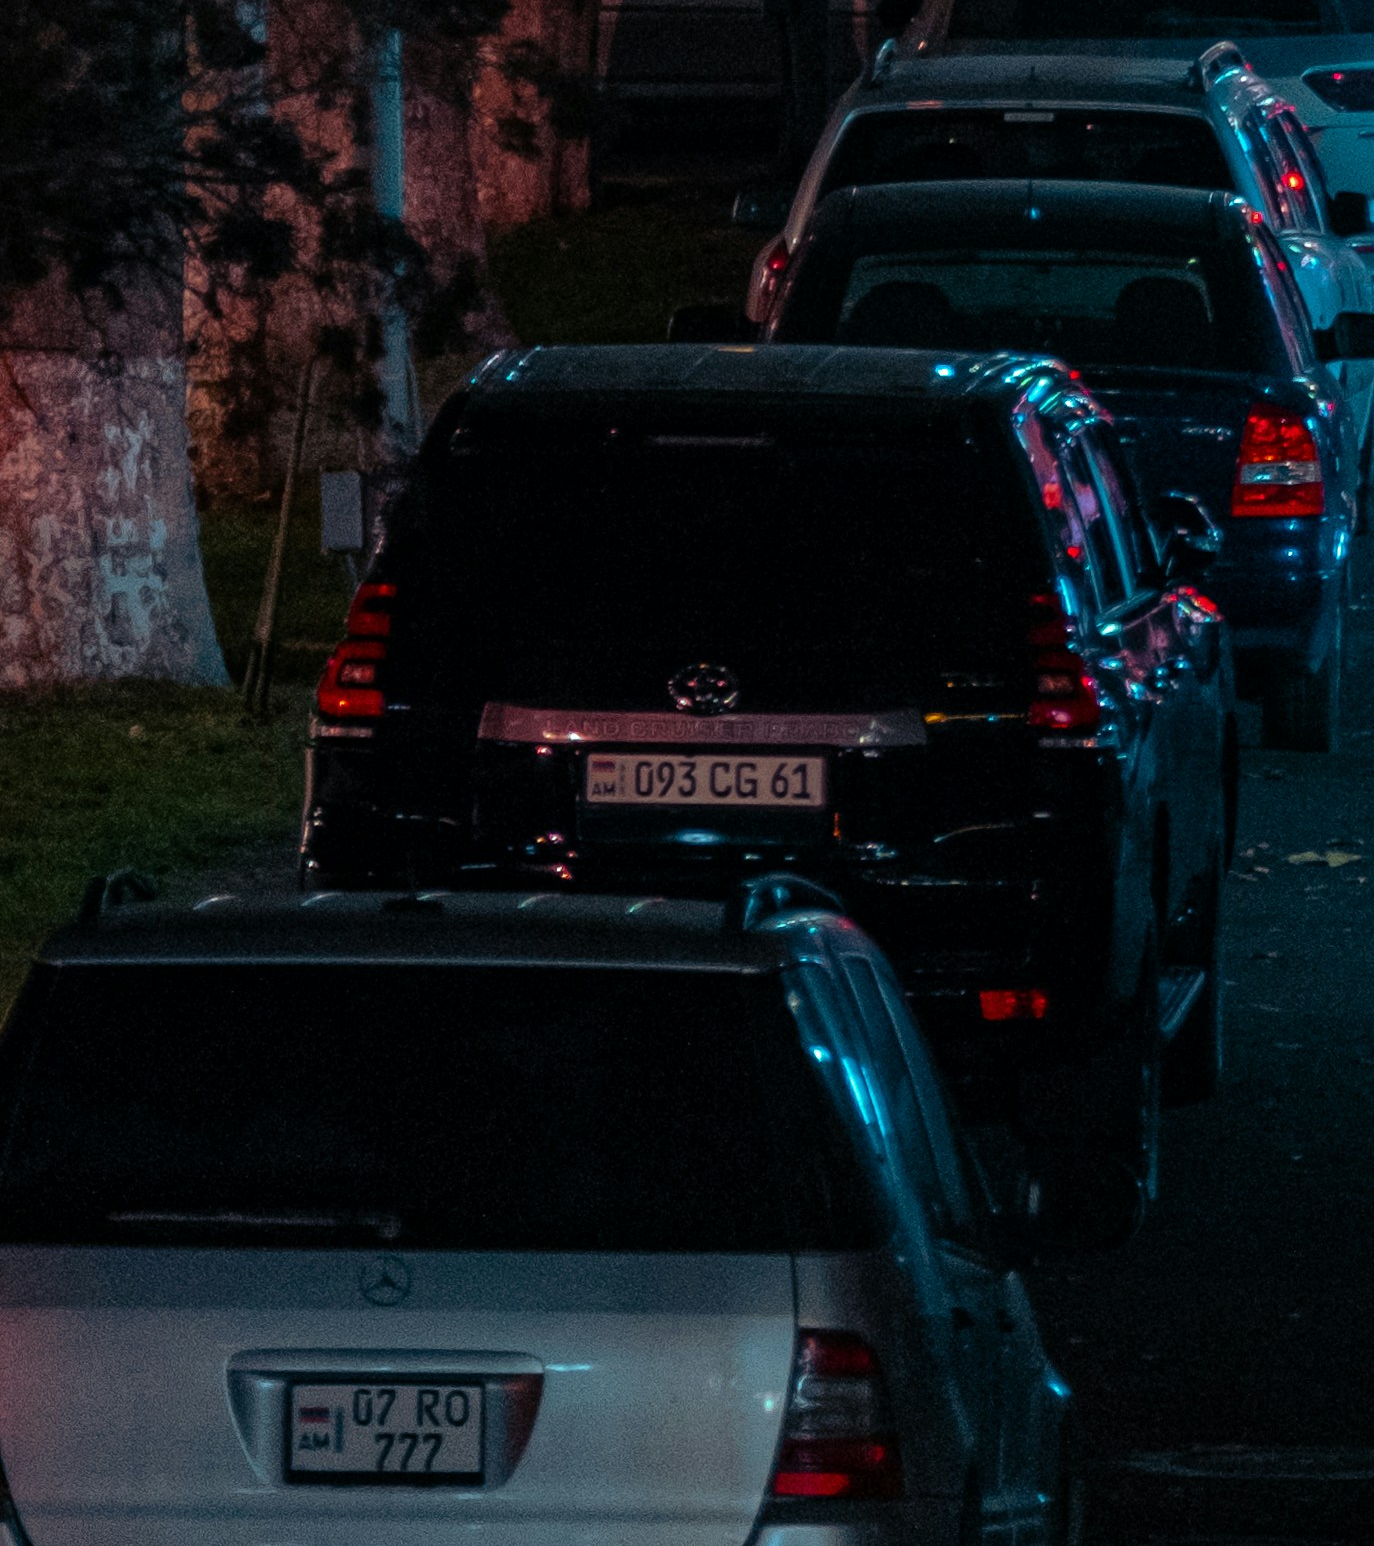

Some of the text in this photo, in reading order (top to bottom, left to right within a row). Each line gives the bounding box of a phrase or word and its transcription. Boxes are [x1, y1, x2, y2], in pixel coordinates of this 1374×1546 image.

[591, 783, 616, 797] AM
[634, 761, 812, 799] 093 CG 61
[353, 1389, 470, 1427] 07 RO
[375, 1432, 443, 1472] 777
